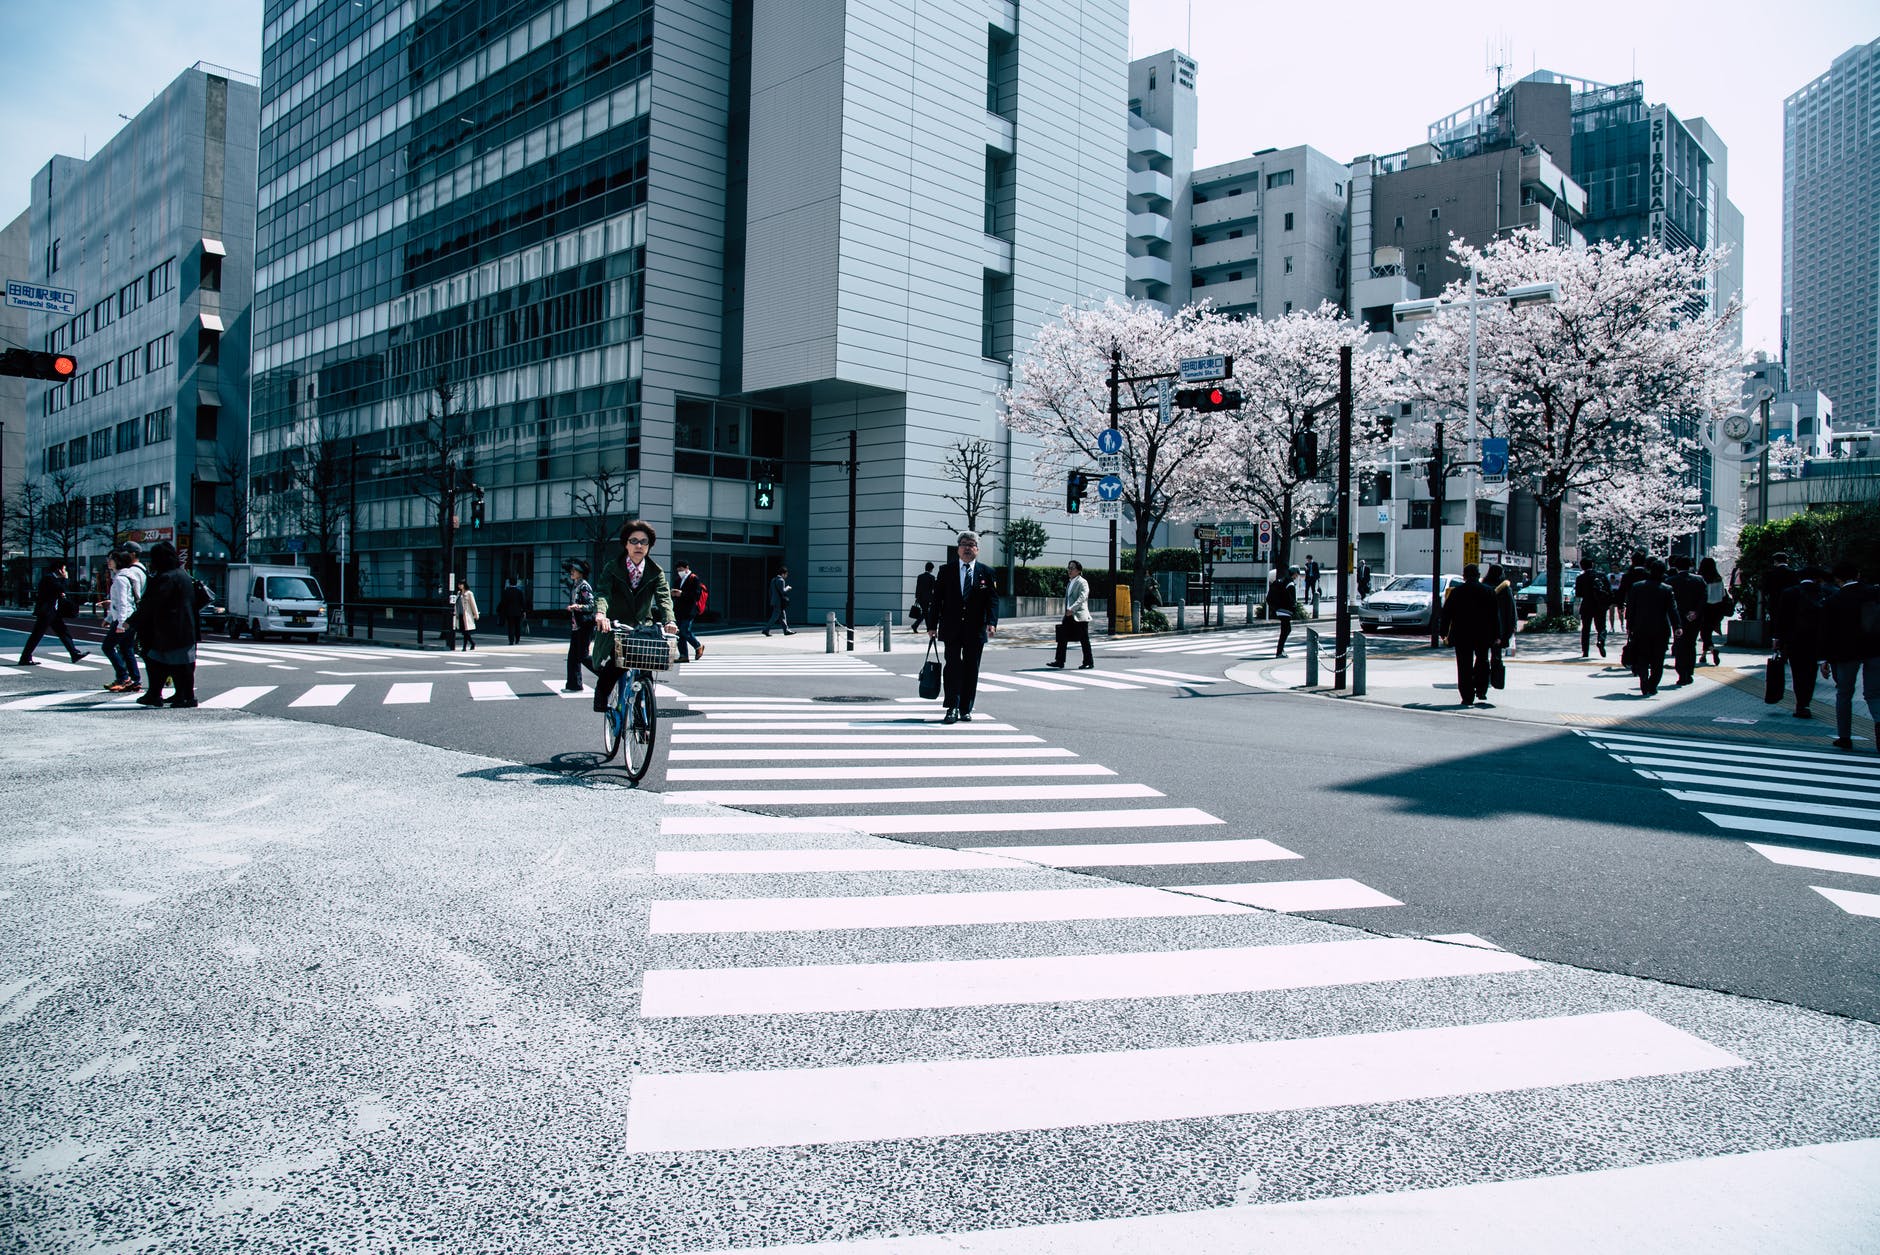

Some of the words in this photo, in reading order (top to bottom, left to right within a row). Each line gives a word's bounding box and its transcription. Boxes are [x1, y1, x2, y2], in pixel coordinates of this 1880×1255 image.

[1651, 119, 1664, 209] SHIBAURA
[9, 283, 75, 304] 田町駅東口
[12, 297, 44, 308] Tamachi
[1181, 358, 1223, 372] 田町駅東口
